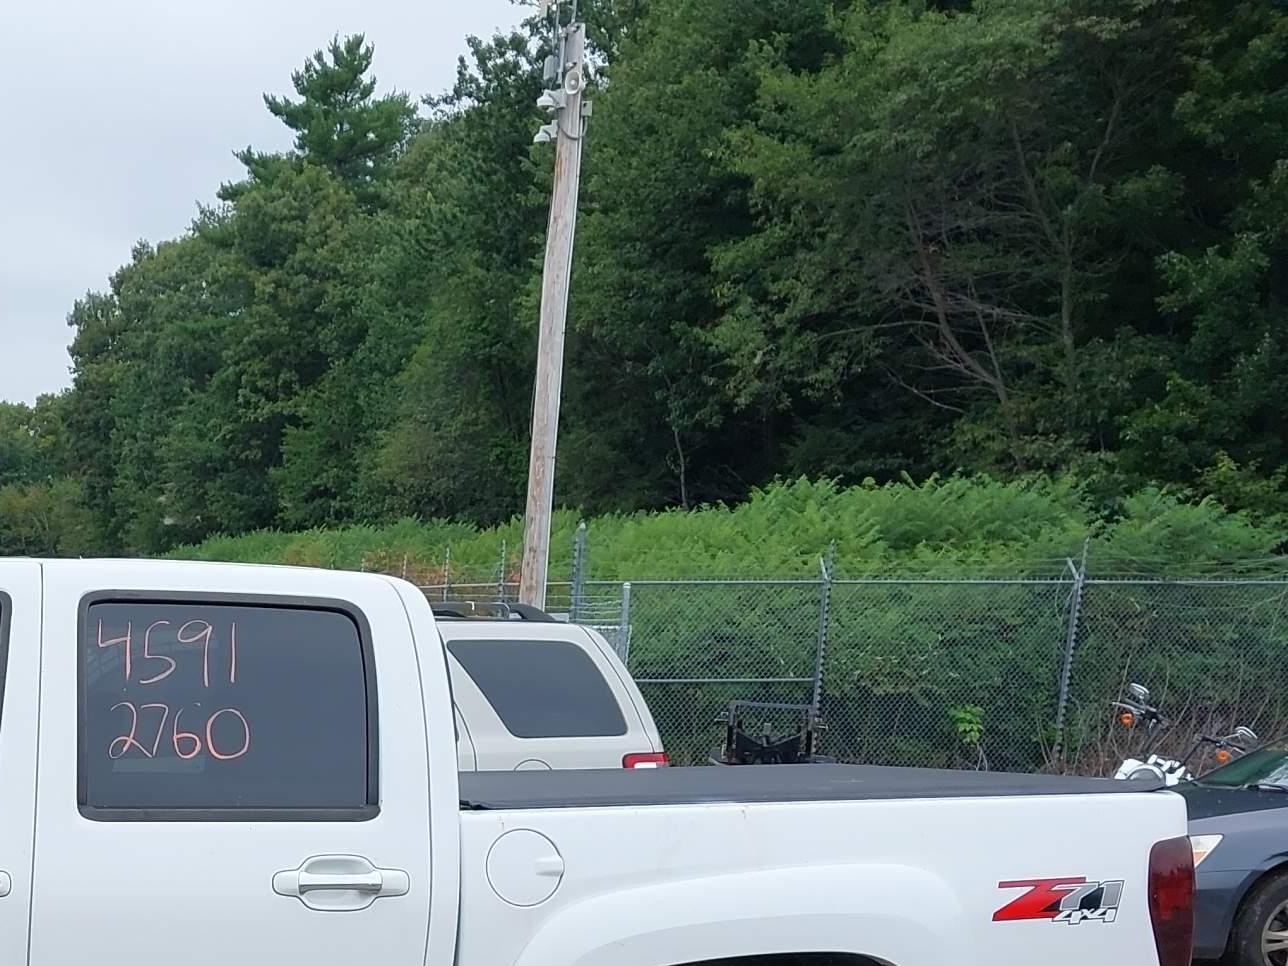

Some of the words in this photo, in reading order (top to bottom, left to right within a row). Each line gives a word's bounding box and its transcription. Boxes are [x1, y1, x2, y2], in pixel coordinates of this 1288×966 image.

[97, 618, 237, 688] 4591
[108, 701, 250, 760] 2760
[991, 876, 1125, 922] Z71
